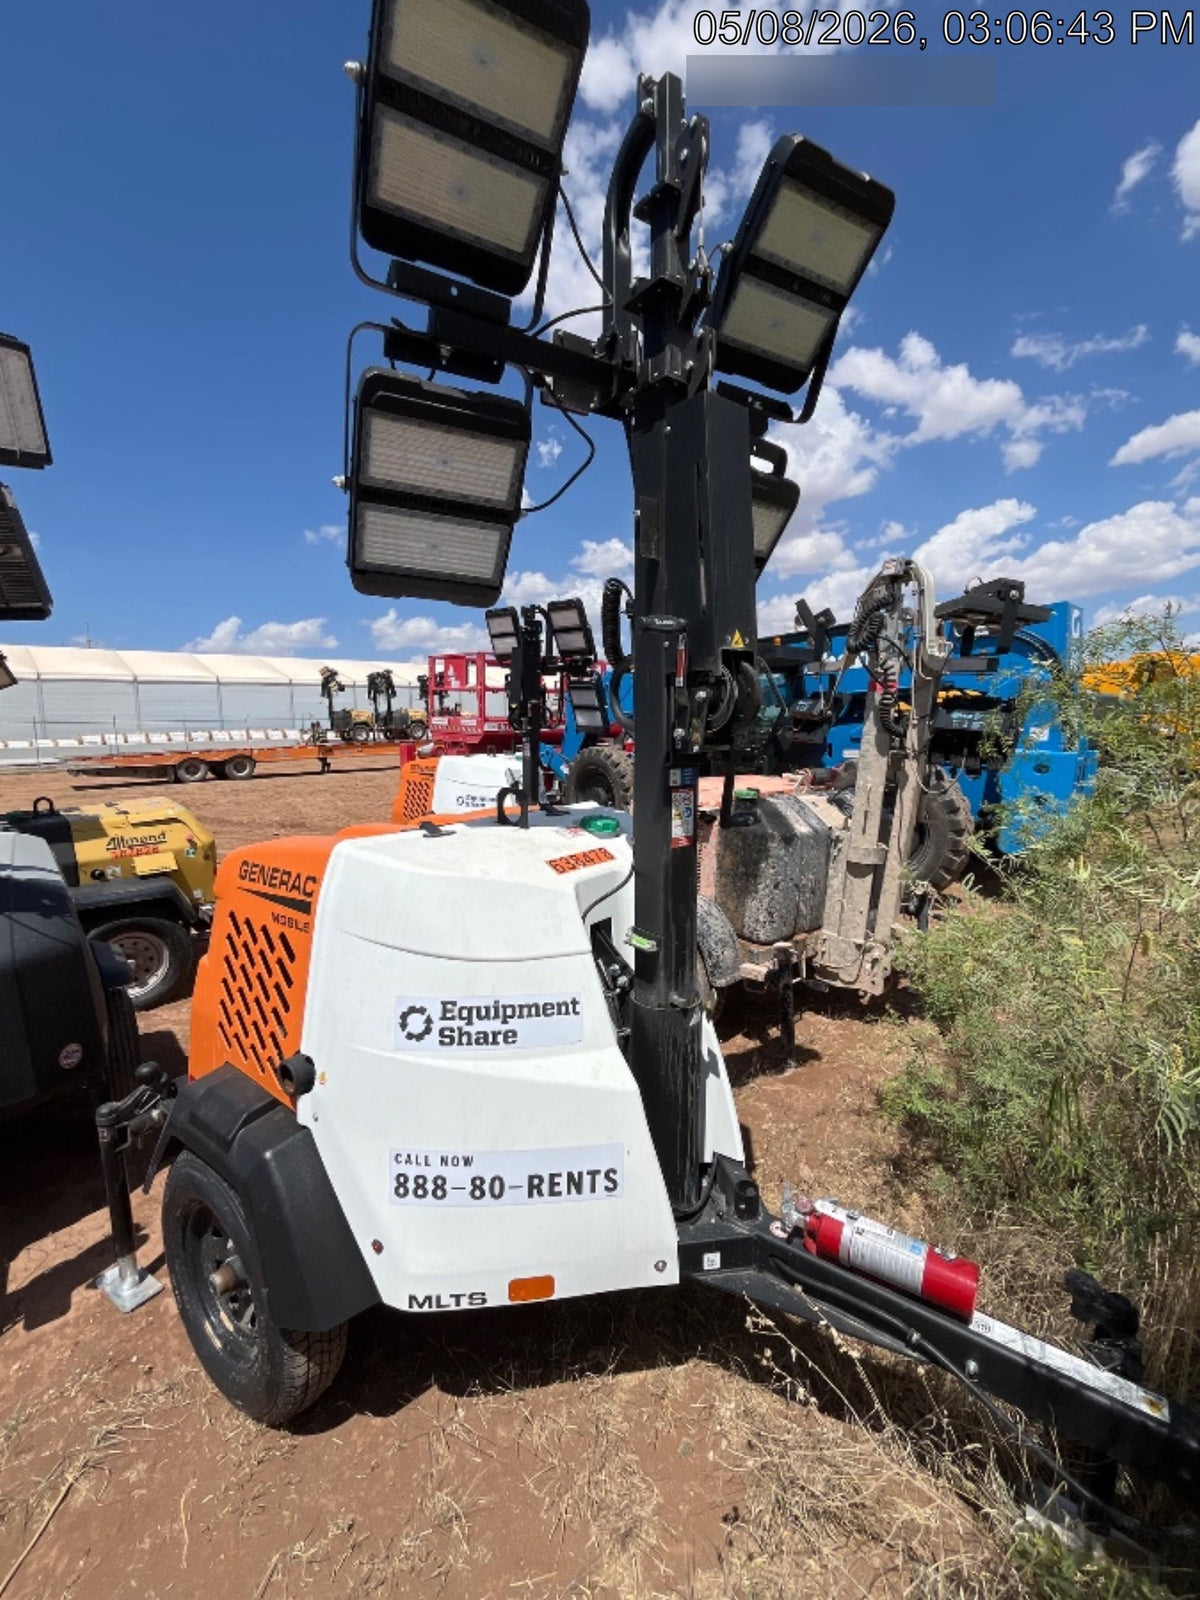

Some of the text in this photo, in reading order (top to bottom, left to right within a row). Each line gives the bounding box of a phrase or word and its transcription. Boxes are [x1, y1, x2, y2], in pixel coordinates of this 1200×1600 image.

[238, 860, 317, 898] GENERAC
[439, 997, 580, 1024] Equipment
[438, 1026, 518, 1047] Share
[394, 1153, 474, 1168] CALL NOW
[393, 1167, 619, 1201] 888-80-RENTS
[408, 1291, 488, 1310] MLTS
